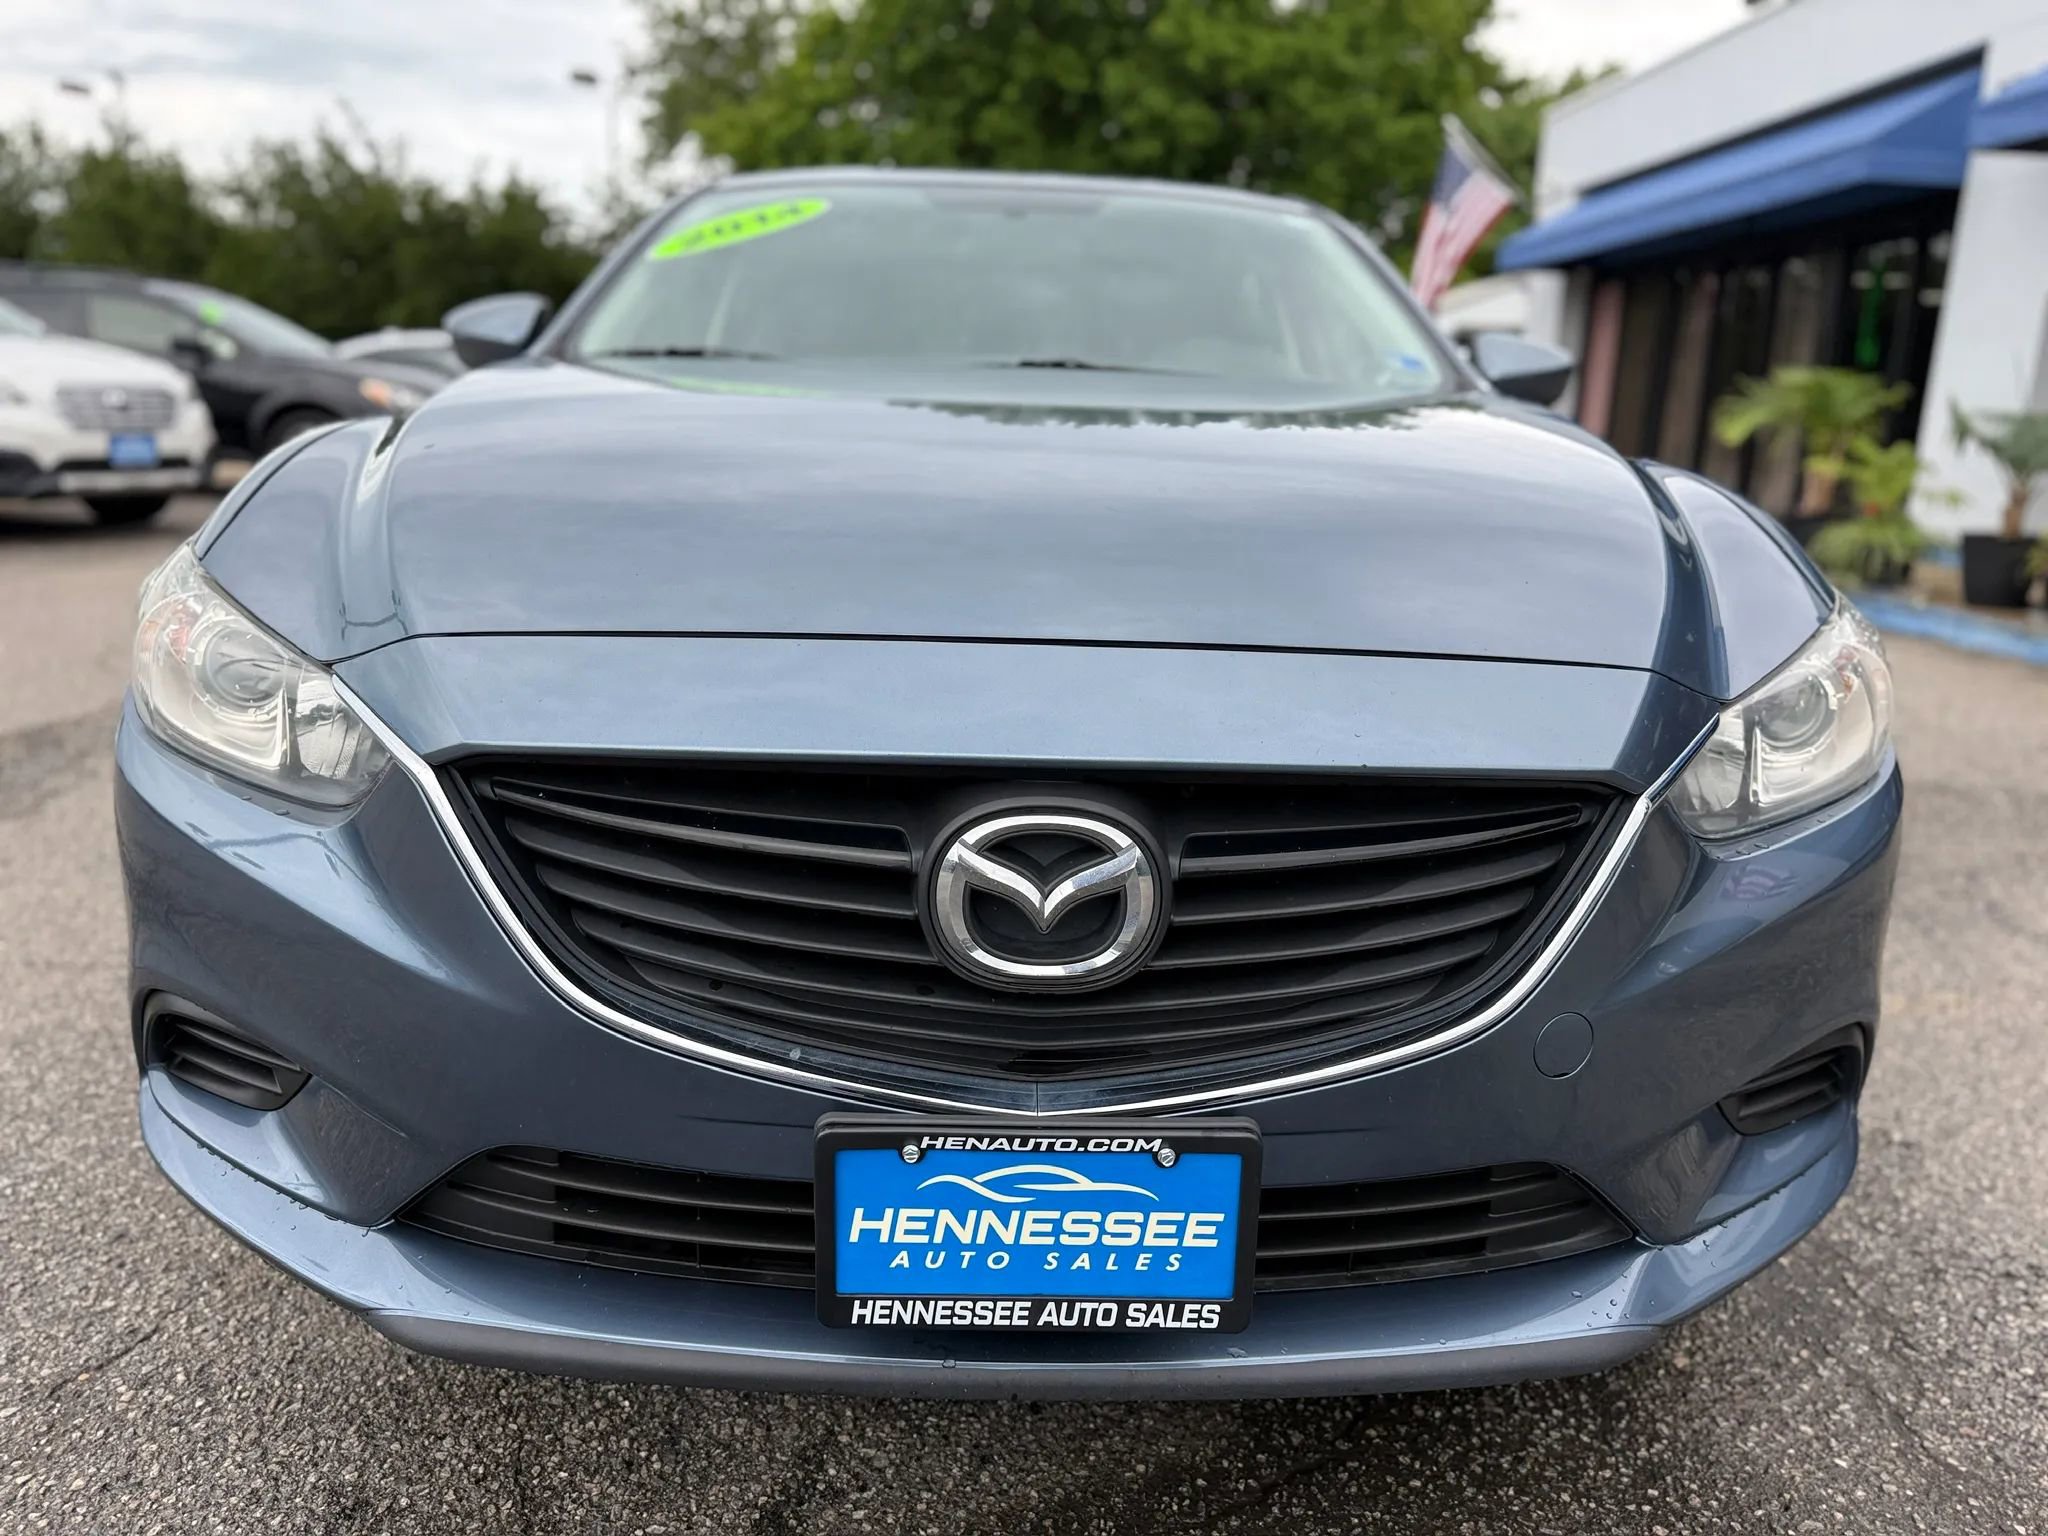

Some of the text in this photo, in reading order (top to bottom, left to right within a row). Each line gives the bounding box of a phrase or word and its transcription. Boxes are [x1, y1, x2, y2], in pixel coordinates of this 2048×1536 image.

[921, 1137, 1162, 1152] HENAUTO.COM
[849, 1208, 1224, 1247] HENNESSEE
[890, 1251, 1182, 1271] AUTO SALES
[852, 1300, 1220, 1328] HENNESSEE AUTO SALES
